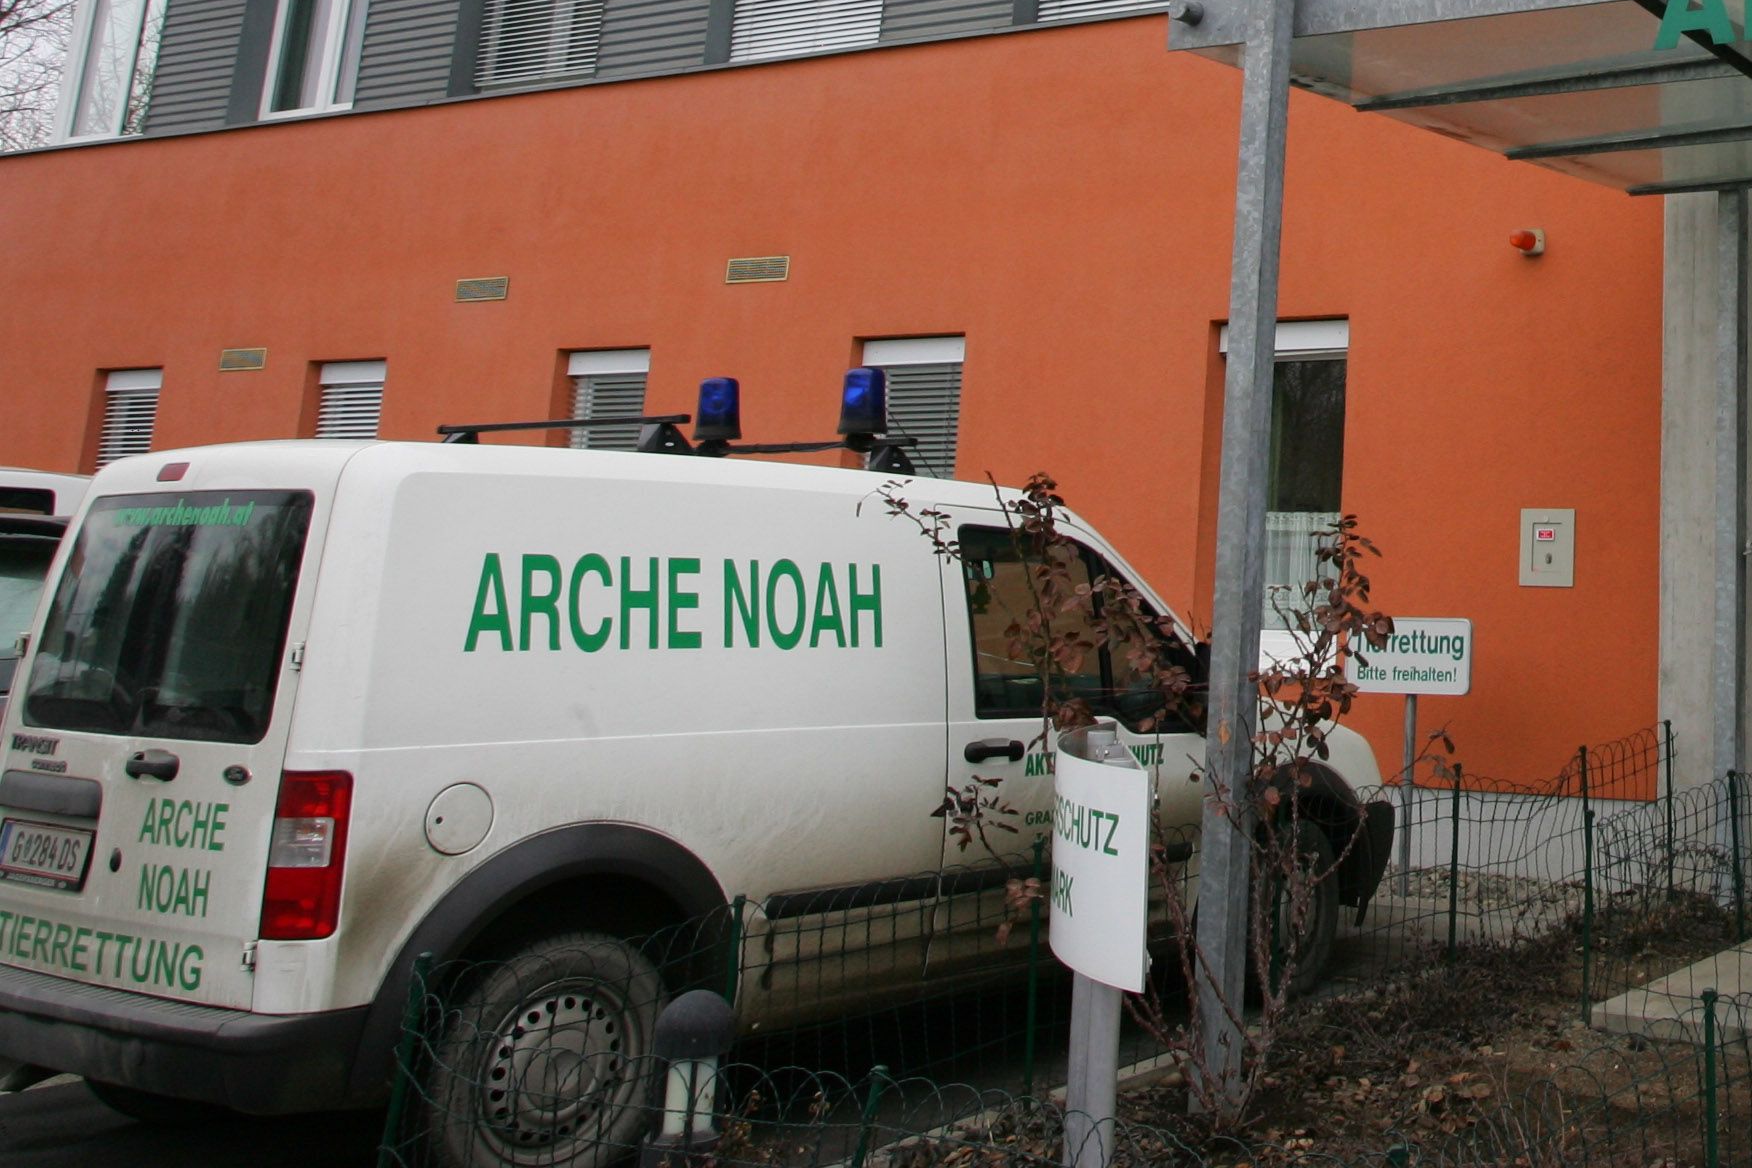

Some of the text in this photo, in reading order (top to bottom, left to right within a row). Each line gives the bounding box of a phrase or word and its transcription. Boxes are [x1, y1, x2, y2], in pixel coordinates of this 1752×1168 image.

[463, 552, 883, 653] ARCHE NOAH
[1357, 666, 1457, 682] Bitte freihalten!
[1126, 743, 1164, 766] HUTZ
[139, 797, 230, 851] ARCHE
[1025, 809, 1054, 826] GRA
[138, 863, 211, 918] NOAH
[0, 910, 204, 991] TIERRETTUNG
